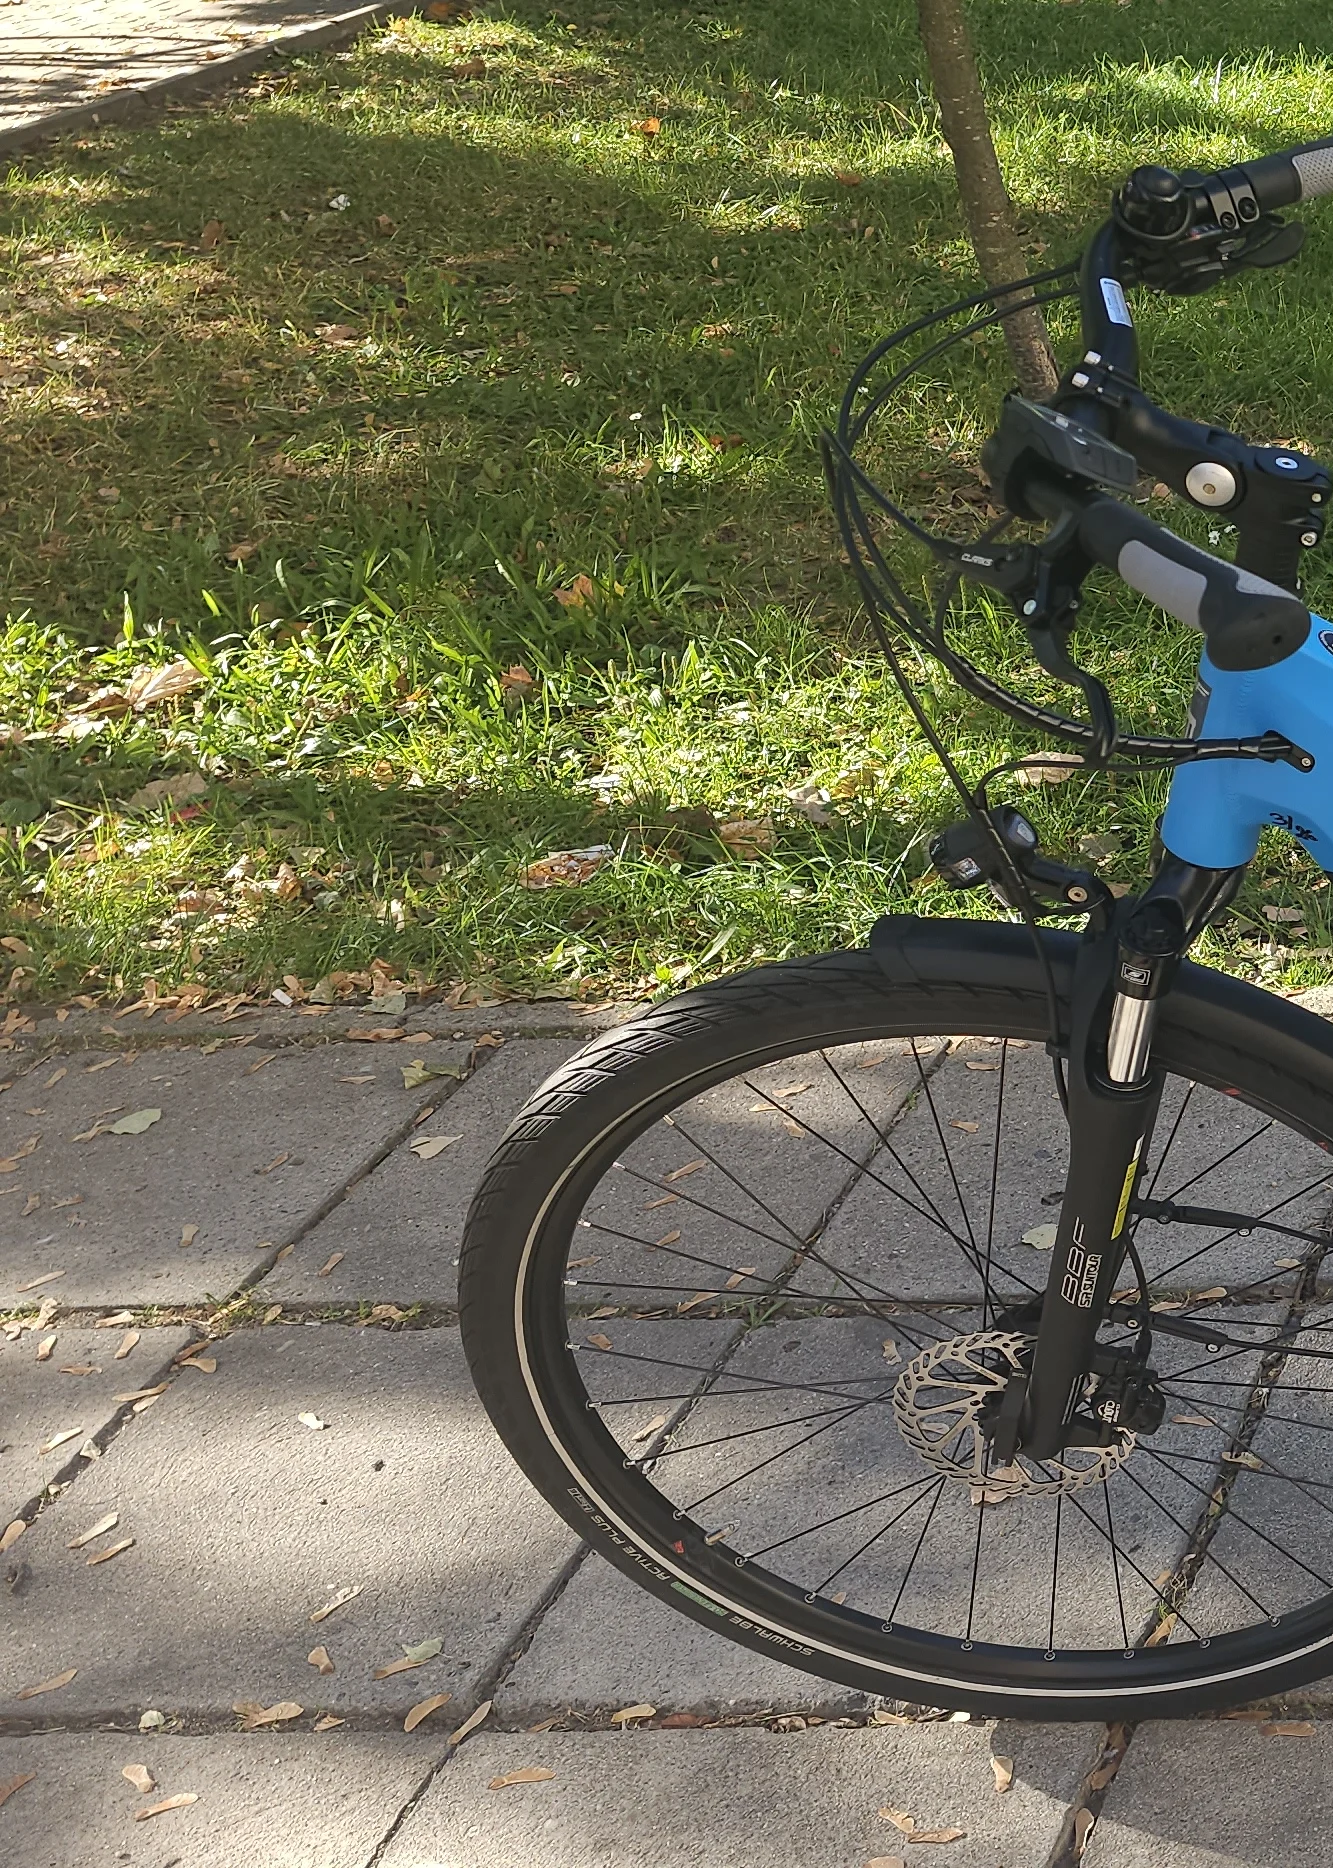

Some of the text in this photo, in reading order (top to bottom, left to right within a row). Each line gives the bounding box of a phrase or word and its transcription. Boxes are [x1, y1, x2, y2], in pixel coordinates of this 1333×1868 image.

[1061, 1216, 1086, 1304] BBF
[591, 1515, 816, 1656] SCHWALBE ACTIVE PLUS
